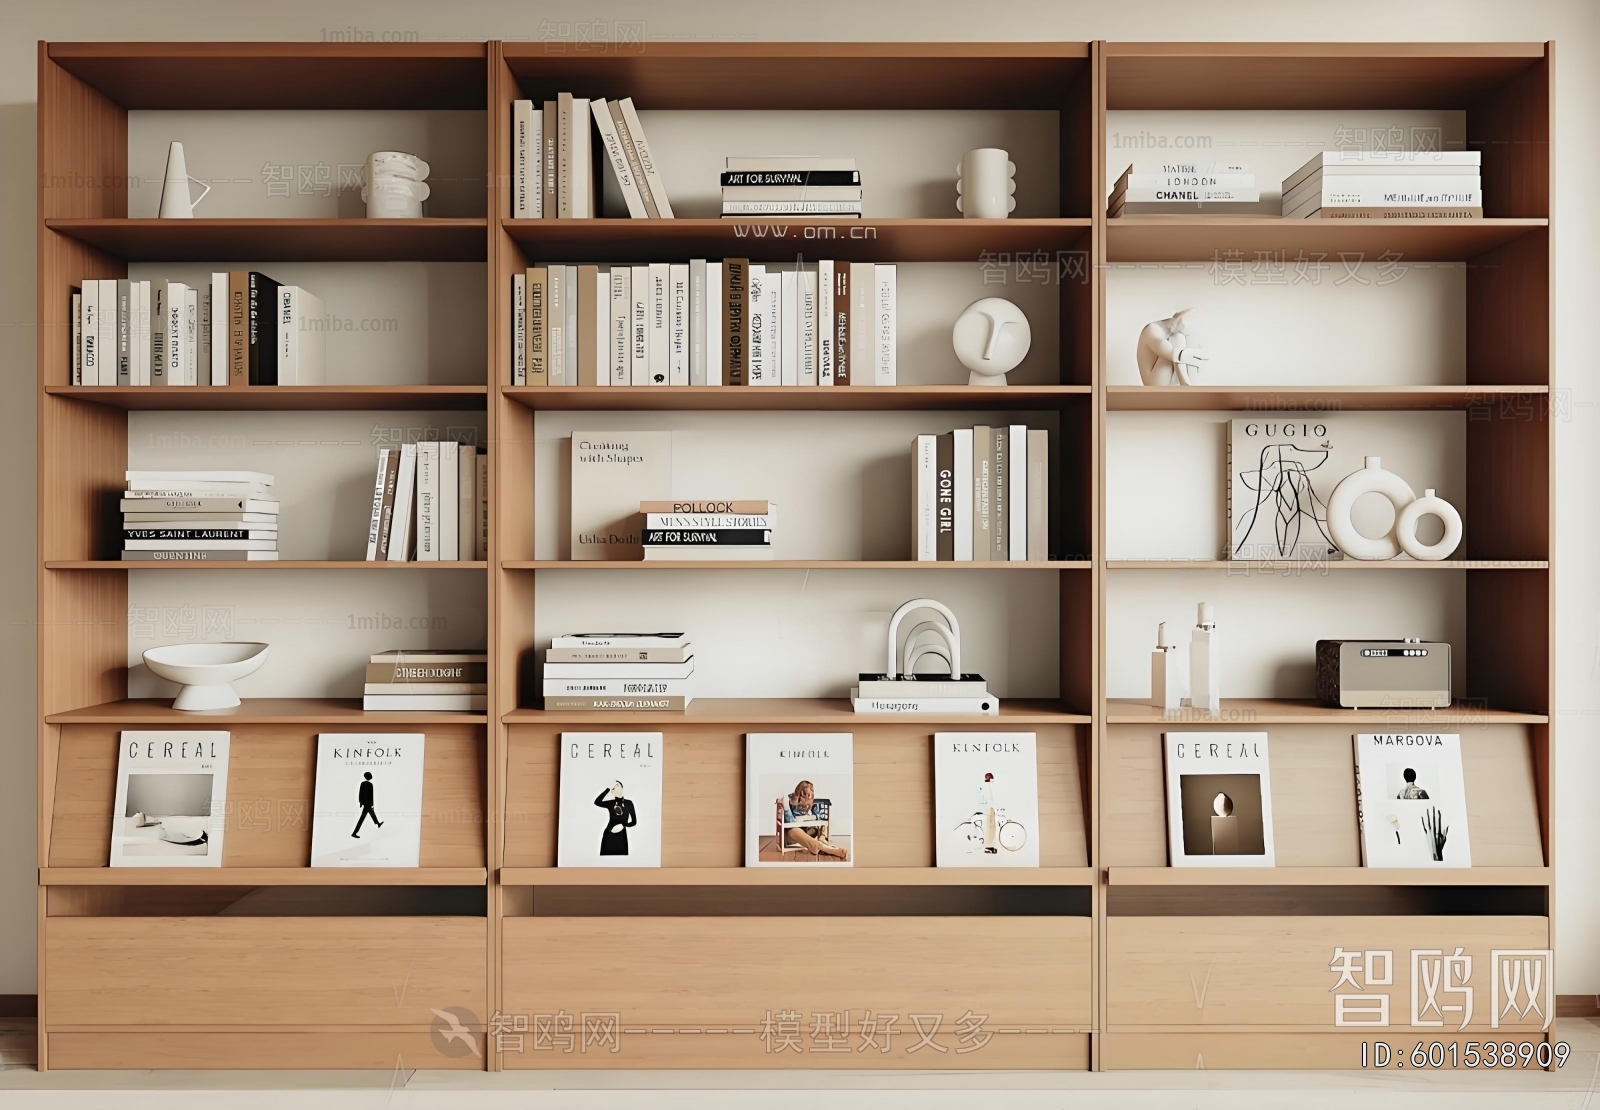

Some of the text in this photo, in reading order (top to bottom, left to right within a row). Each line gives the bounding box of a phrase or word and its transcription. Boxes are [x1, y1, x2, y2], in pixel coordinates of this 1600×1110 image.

[1156, 191, 1199, 200] CHANEL
[940, 469, 952, 534] GONE GIRL
[673, 502, 734, 514] POLLOCK
[159, 530, 191, 538] SAINT
[1373, 735, 1443, 746] MARGOVA
[129, 741, 217, 759] CEREAL
[333, 747, 402, 759] KINFOLK
[570, 743, 654, 759] CEREAL
[1177, 743, 1260, 759] CEREAL
